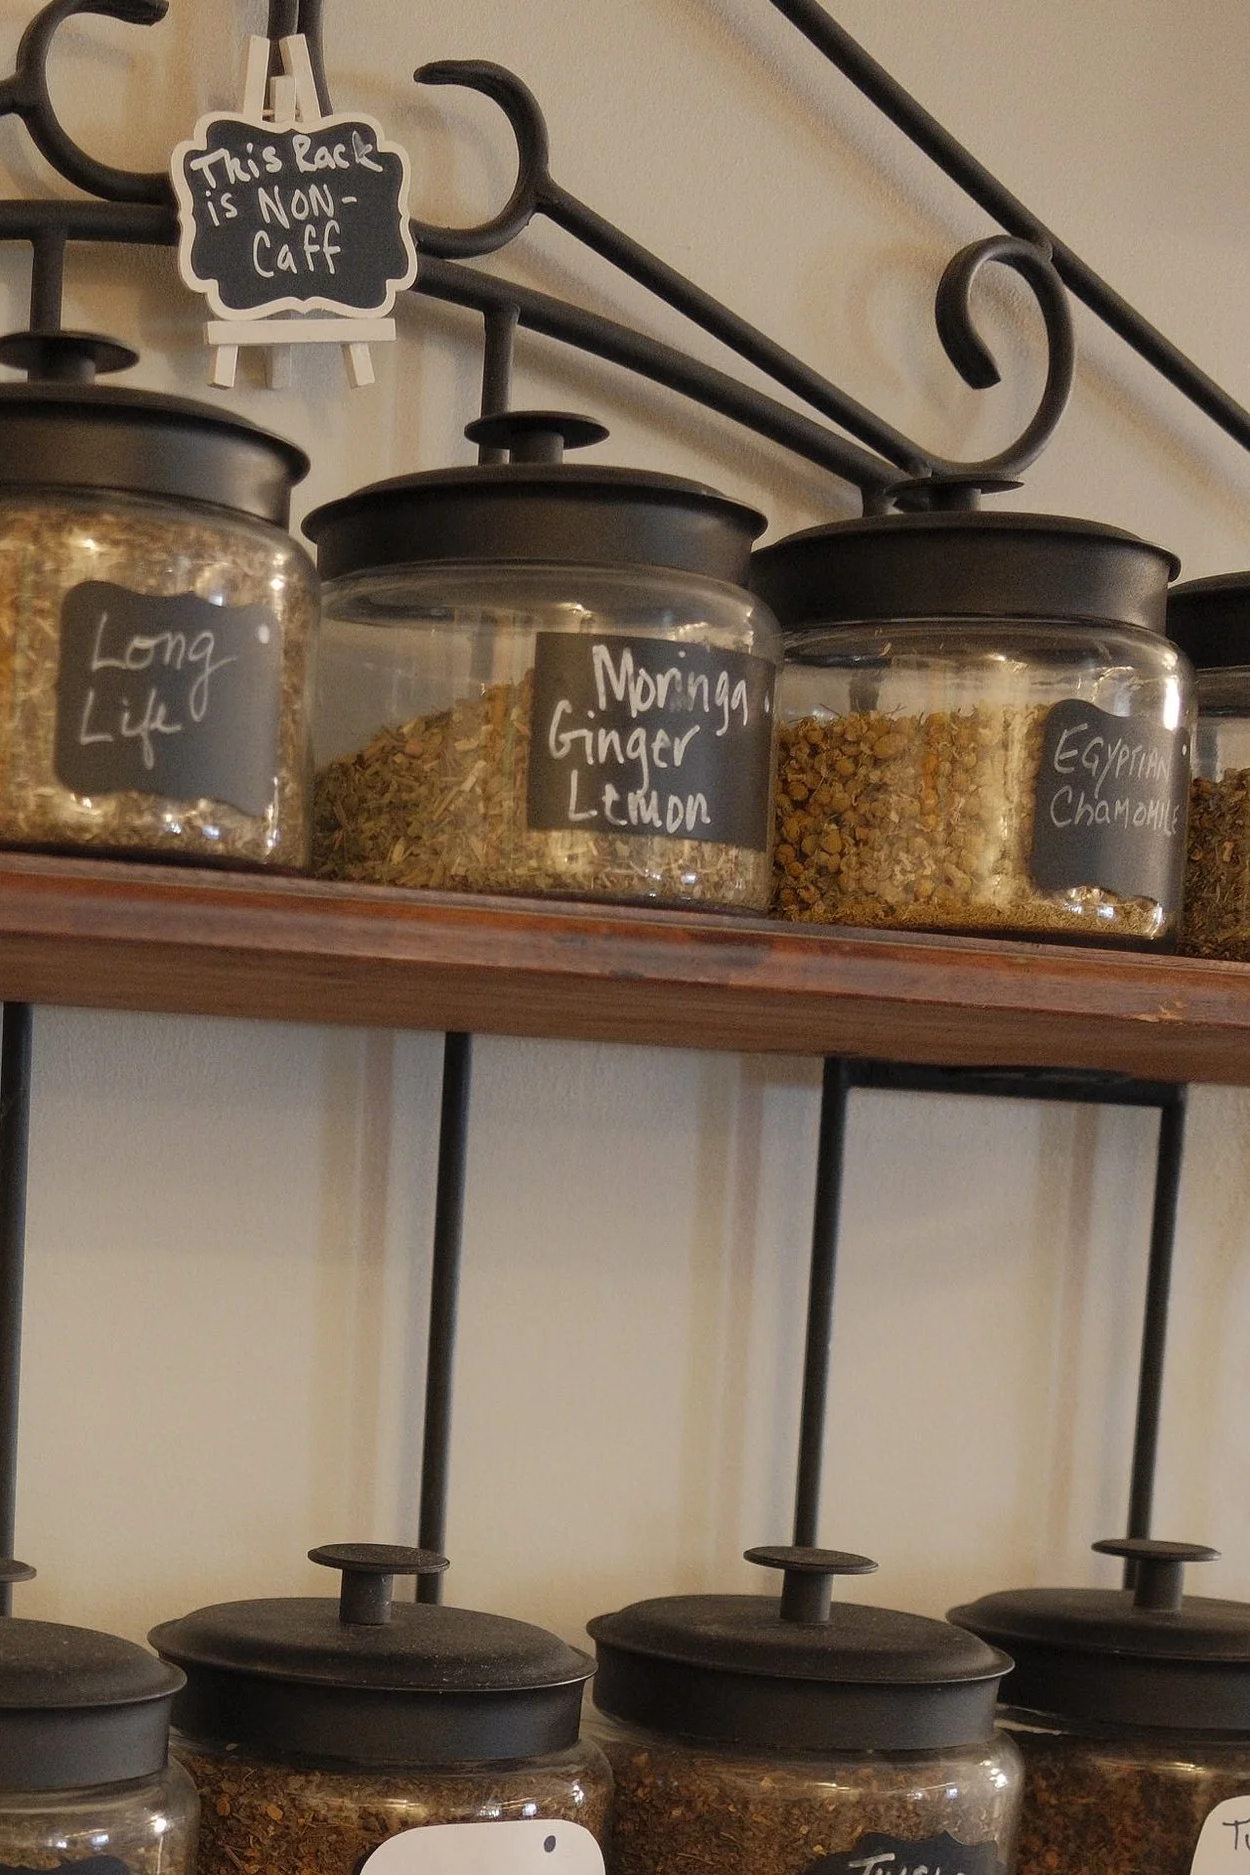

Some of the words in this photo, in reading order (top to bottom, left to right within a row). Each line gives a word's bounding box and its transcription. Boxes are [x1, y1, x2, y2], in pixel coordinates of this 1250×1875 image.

[191, 142, 282, 189] This
[292, 131, 384, 173] Rack
[205, 190, 238, 227] is
[252, 220, 342, 277] Caff
[90, 610, 239, 723] Long
[592, 644, 749, 737] Moringa
[79, 686, 183, 771] Life
[548, 699, 701, 799] Ginger
[567, 768, 712, 834] Lemon
